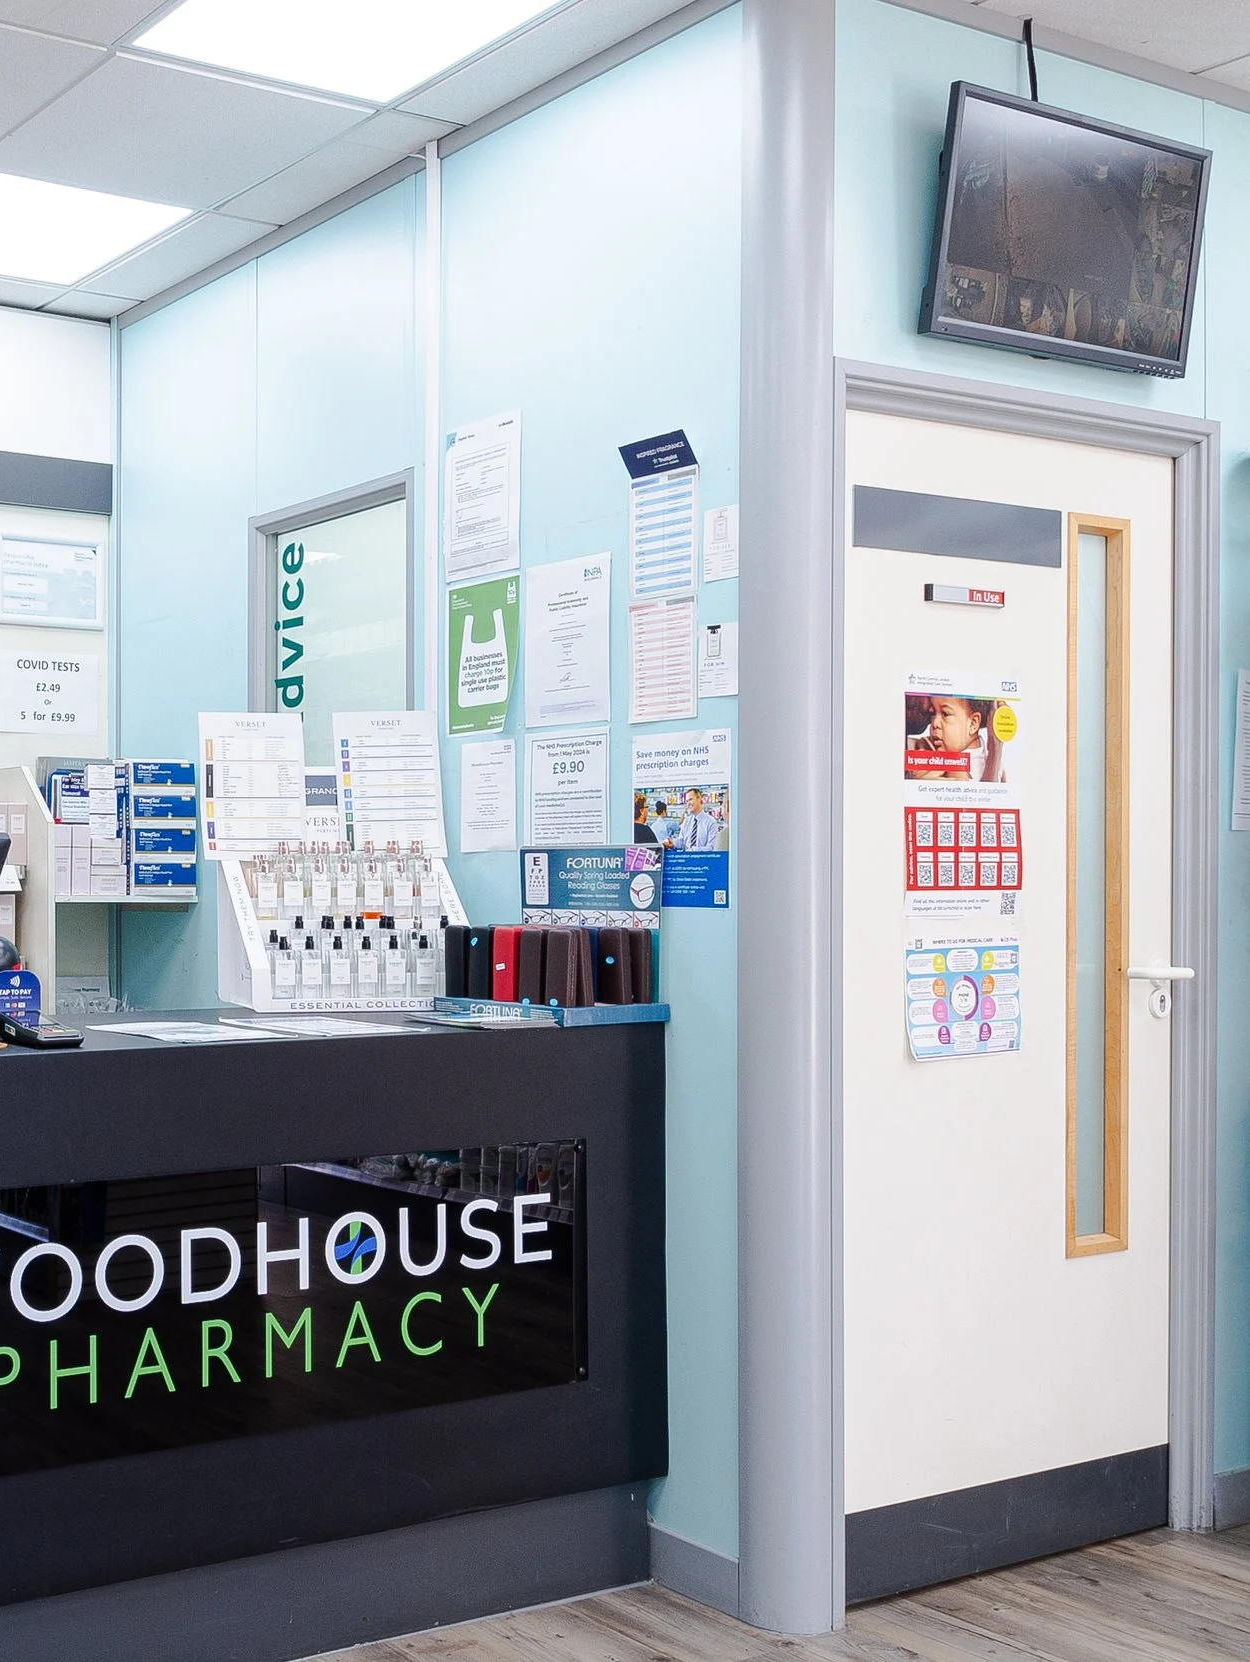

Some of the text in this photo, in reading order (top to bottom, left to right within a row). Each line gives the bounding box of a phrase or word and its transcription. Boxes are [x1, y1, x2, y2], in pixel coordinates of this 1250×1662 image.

[657, 441, 685, 453] FRAGRANCE
[973, 591, 1000, 603] In Use
[274, 542, 304, 722] dvice
[465, 651, 503, 664] All businesses
[17, 658, 80, 673] COVID TESTS
[468, 660, 491, 671] England
[491, 658, 506, 667] must
[464, 669, 483, 680] charge
[494, 666, 503, 675] for
[461, 677, 477, 688] single
[488, 673, 506, 685] plastic
[36, 682, 61, 693] £2.49
[467, 682, 500, 694] carrier bags
[1001, 682, 1017, 692] NHS
[20, 710, 76, 723] 5 for £9.99
[556, 741, 585, 750] Prescription
[585, 739, 602, 748] Charge
[636, 745, 710, 759] Save money on NHS
[552, 760, 585, 774] £9.90
[636, 758, 710, 772] prescription charges
[914, 757, 929, 766] your
[929, 756, 944, 766] child
[928, 786, 945, 794] expert
[305, 816, 340, 826] VERS
[566, 857, 623, 869] FORTUNA
[558, 870, 630, 881] Quality Spring Loaded
[568, 881, 620, 891] Reading Glasses
[290, 1001, 361, 1010] ESSENTIAL
[469, 1003, 523, 1018] FORTUNA
